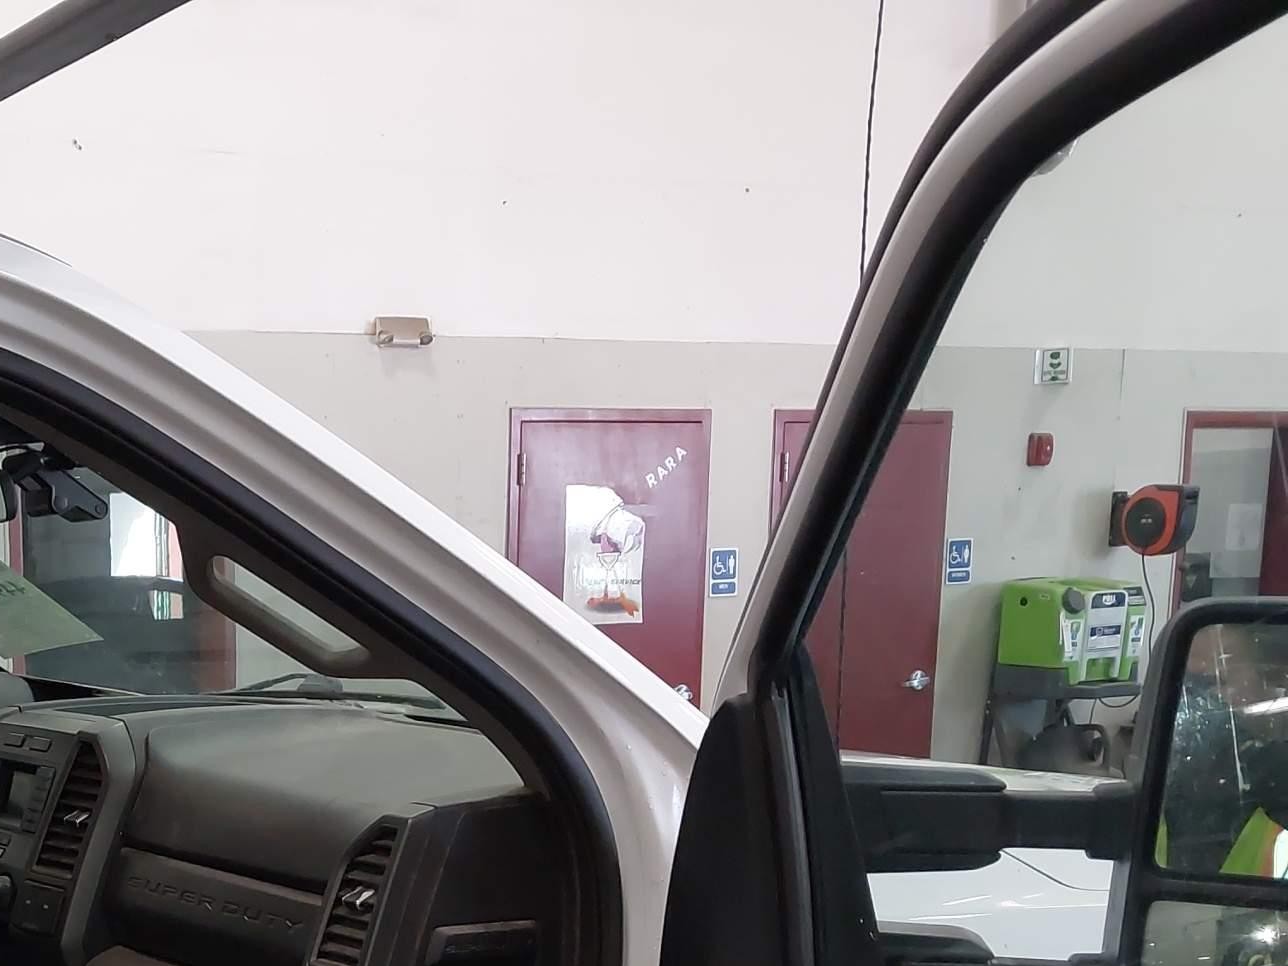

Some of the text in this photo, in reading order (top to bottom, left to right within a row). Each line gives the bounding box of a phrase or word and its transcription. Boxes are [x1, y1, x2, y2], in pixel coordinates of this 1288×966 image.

[645, 446, 687, 488] RARA
[127, 876, 304, 934] SUPER DUTY
